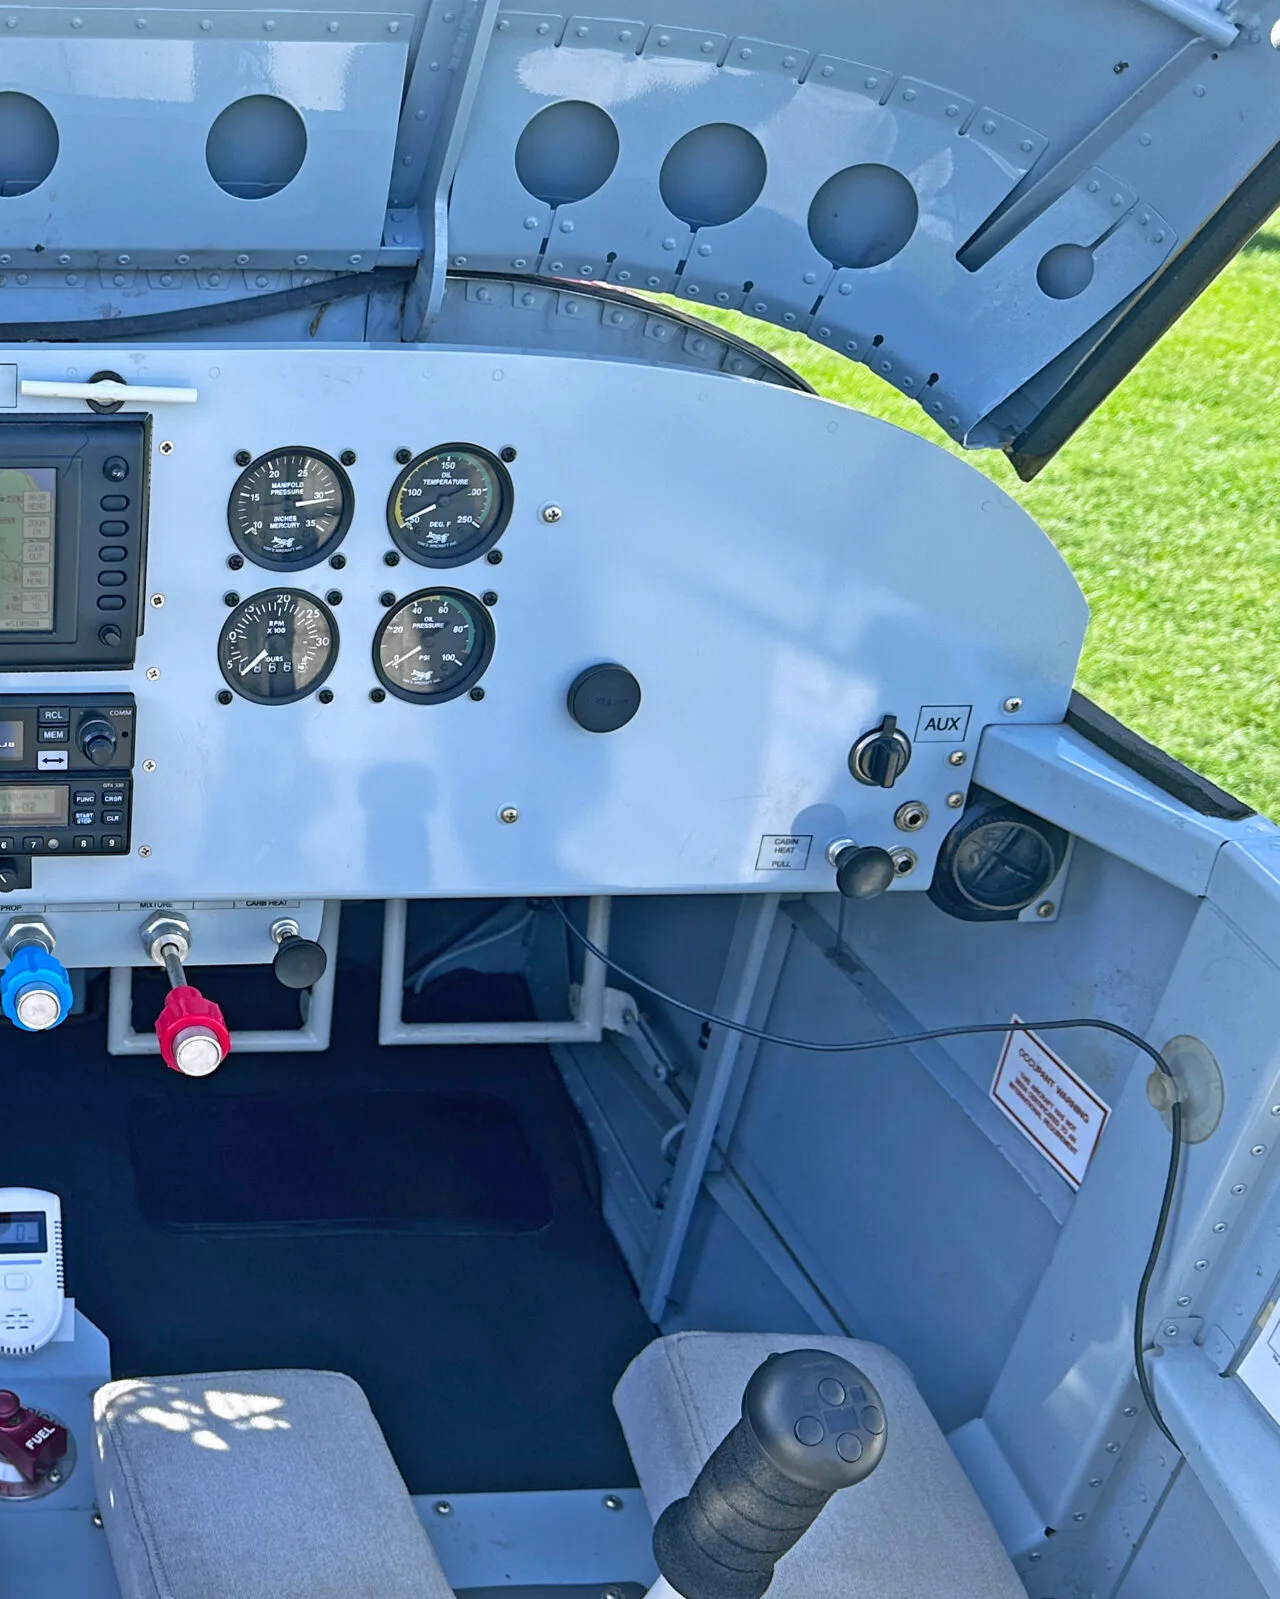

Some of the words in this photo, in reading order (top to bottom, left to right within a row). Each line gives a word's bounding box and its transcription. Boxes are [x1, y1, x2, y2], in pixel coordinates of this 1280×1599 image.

[440, 462, 455, 470] 150
[269, 470, 279, 478] 20
[297, 469, 308, 477] 25
[423, 478, 468, 486] TEMPERATURE
[313, 491, 324, 499] 30
[408, 488, 422, 496] 100
[250, 493, 260, 501] 15
[457, 516, 472, 524] 250
[253, 521, 263, 529] 10
[277, 595, 291, 603] 20
[307, 609, 320, 618] 25
[412, 606, 422, 614] 40
[438, 606, 448, 614] 60
[393, 626, 403, 634] 20
[453, 625, 464, 633] 80
[315, 637, 330, 646] 30
[442, 654, 455, 662] 100
[45, 711, 63, 719] RCL
[924, 718, 961, 731] AUX
[44, 731, 64, 739] MEM
[771, 860, 792, 868] PULL
[1018, 1047, 1056, 1088] OCCUPANT
[1056, 1086, 1090, 1124] WARNING
[16, 1224, 25, 1241] 0
[25, 1426, 56, 1451] FUEL
